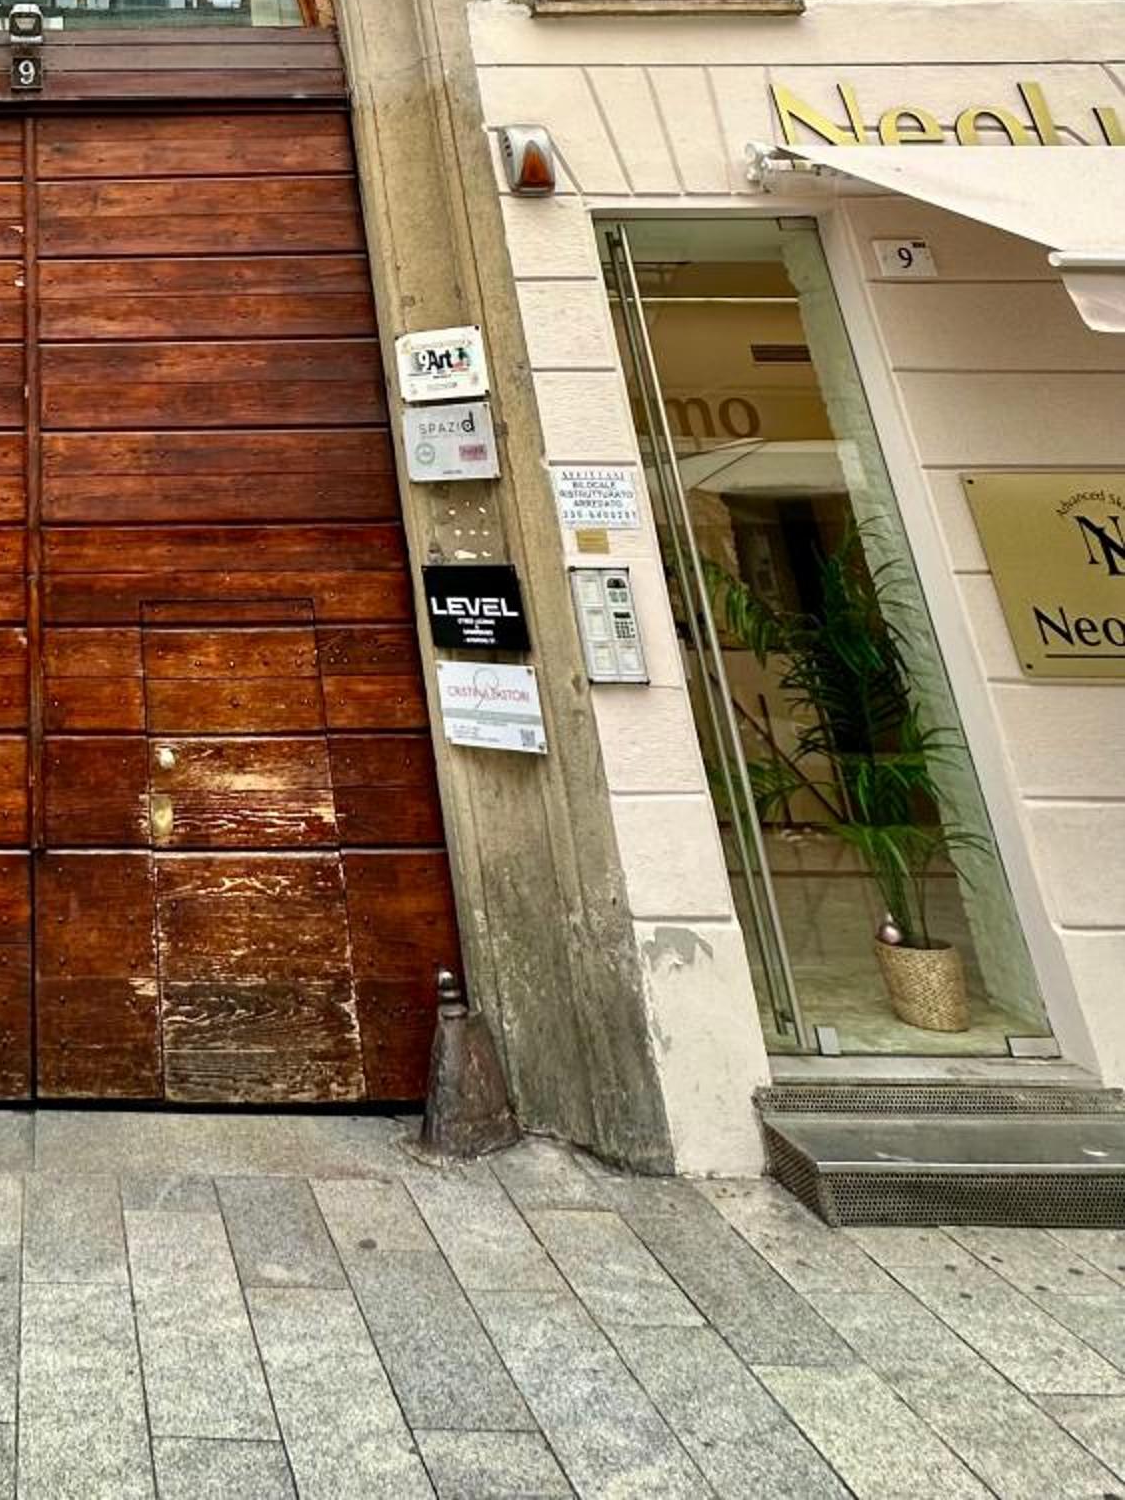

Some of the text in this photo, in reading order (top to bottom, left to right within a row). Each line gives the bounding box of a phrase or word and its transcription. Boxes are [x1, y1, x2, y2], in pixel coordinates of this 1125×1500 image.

[19, 61, 35, 85] 9
[897, 247, 913, 268] 9
[430, 596, 520, 617] LEVEL
